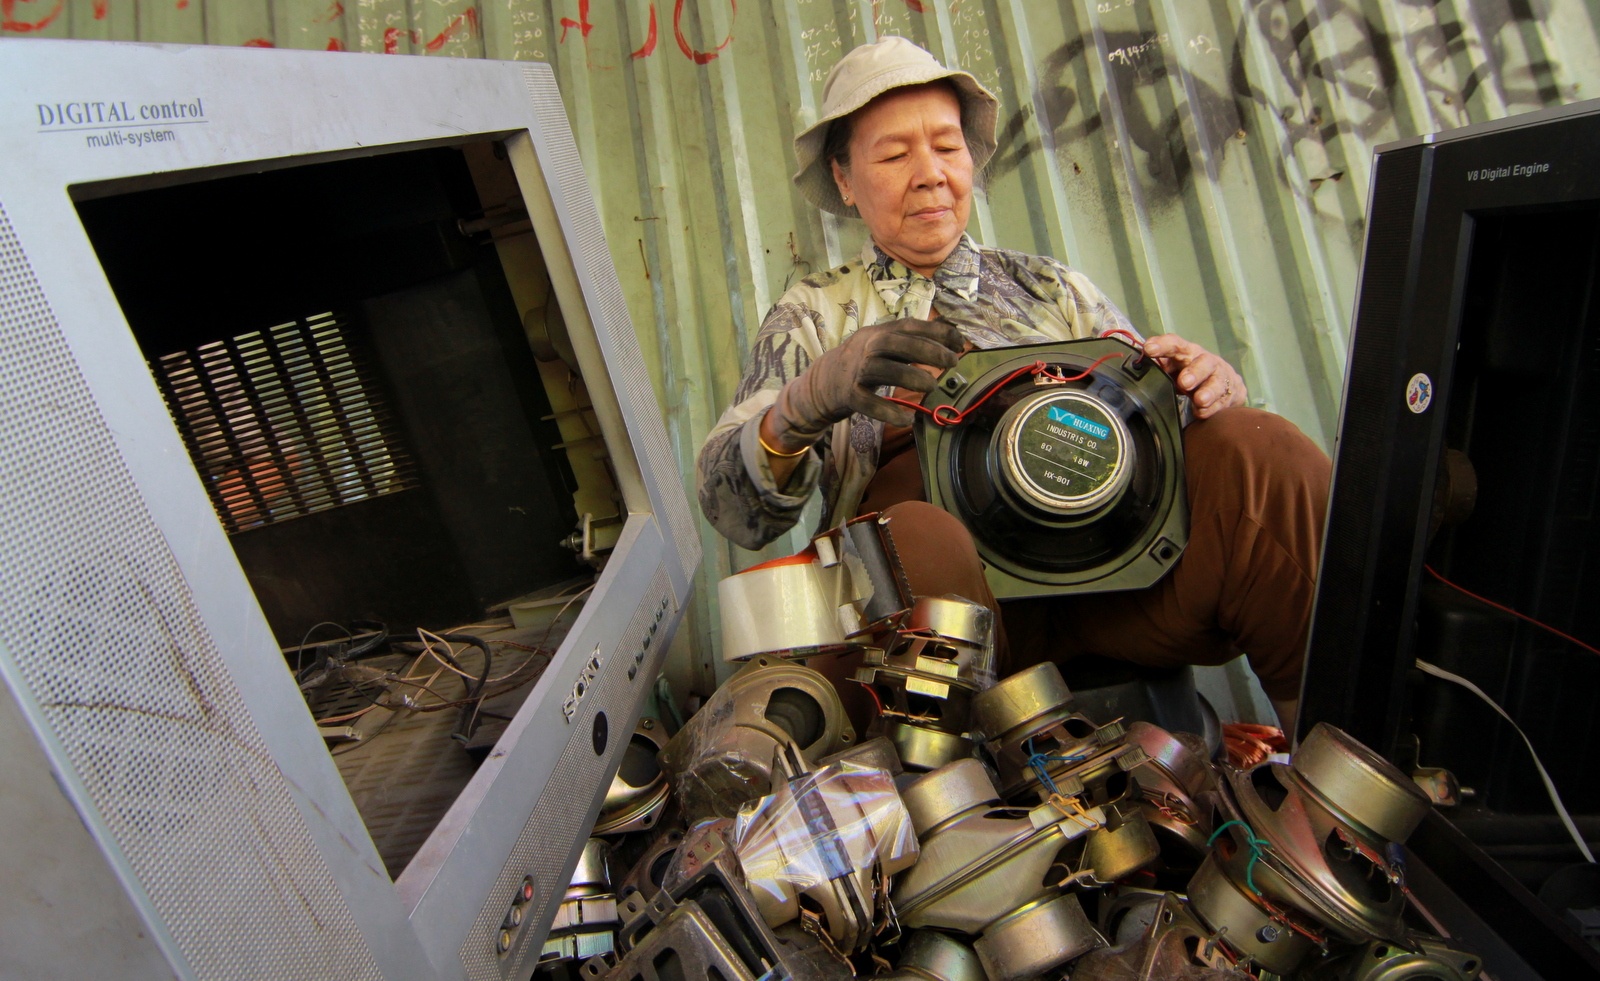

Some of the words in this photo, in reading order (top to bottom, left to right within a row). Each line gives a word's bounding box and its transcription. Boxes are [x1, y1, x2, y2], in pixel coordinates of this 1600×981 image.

[37, 101, 136, 127] DIGITAL
[139, 98, 204, 120] control
[86, 127, 176, 148] multi-system
[1467, 170, 1479, 181] V8
[1480, 166, 1511, 181] Digital
[1512, 162, 1550, 177] Engine
[1046, 424, 1084, 444] INDUSTRIS
[1073, 418, 1107, 437] HUAXING
[1044, 470, 1071, 486] HX-801
[562, 642, 602, 724] SONY
